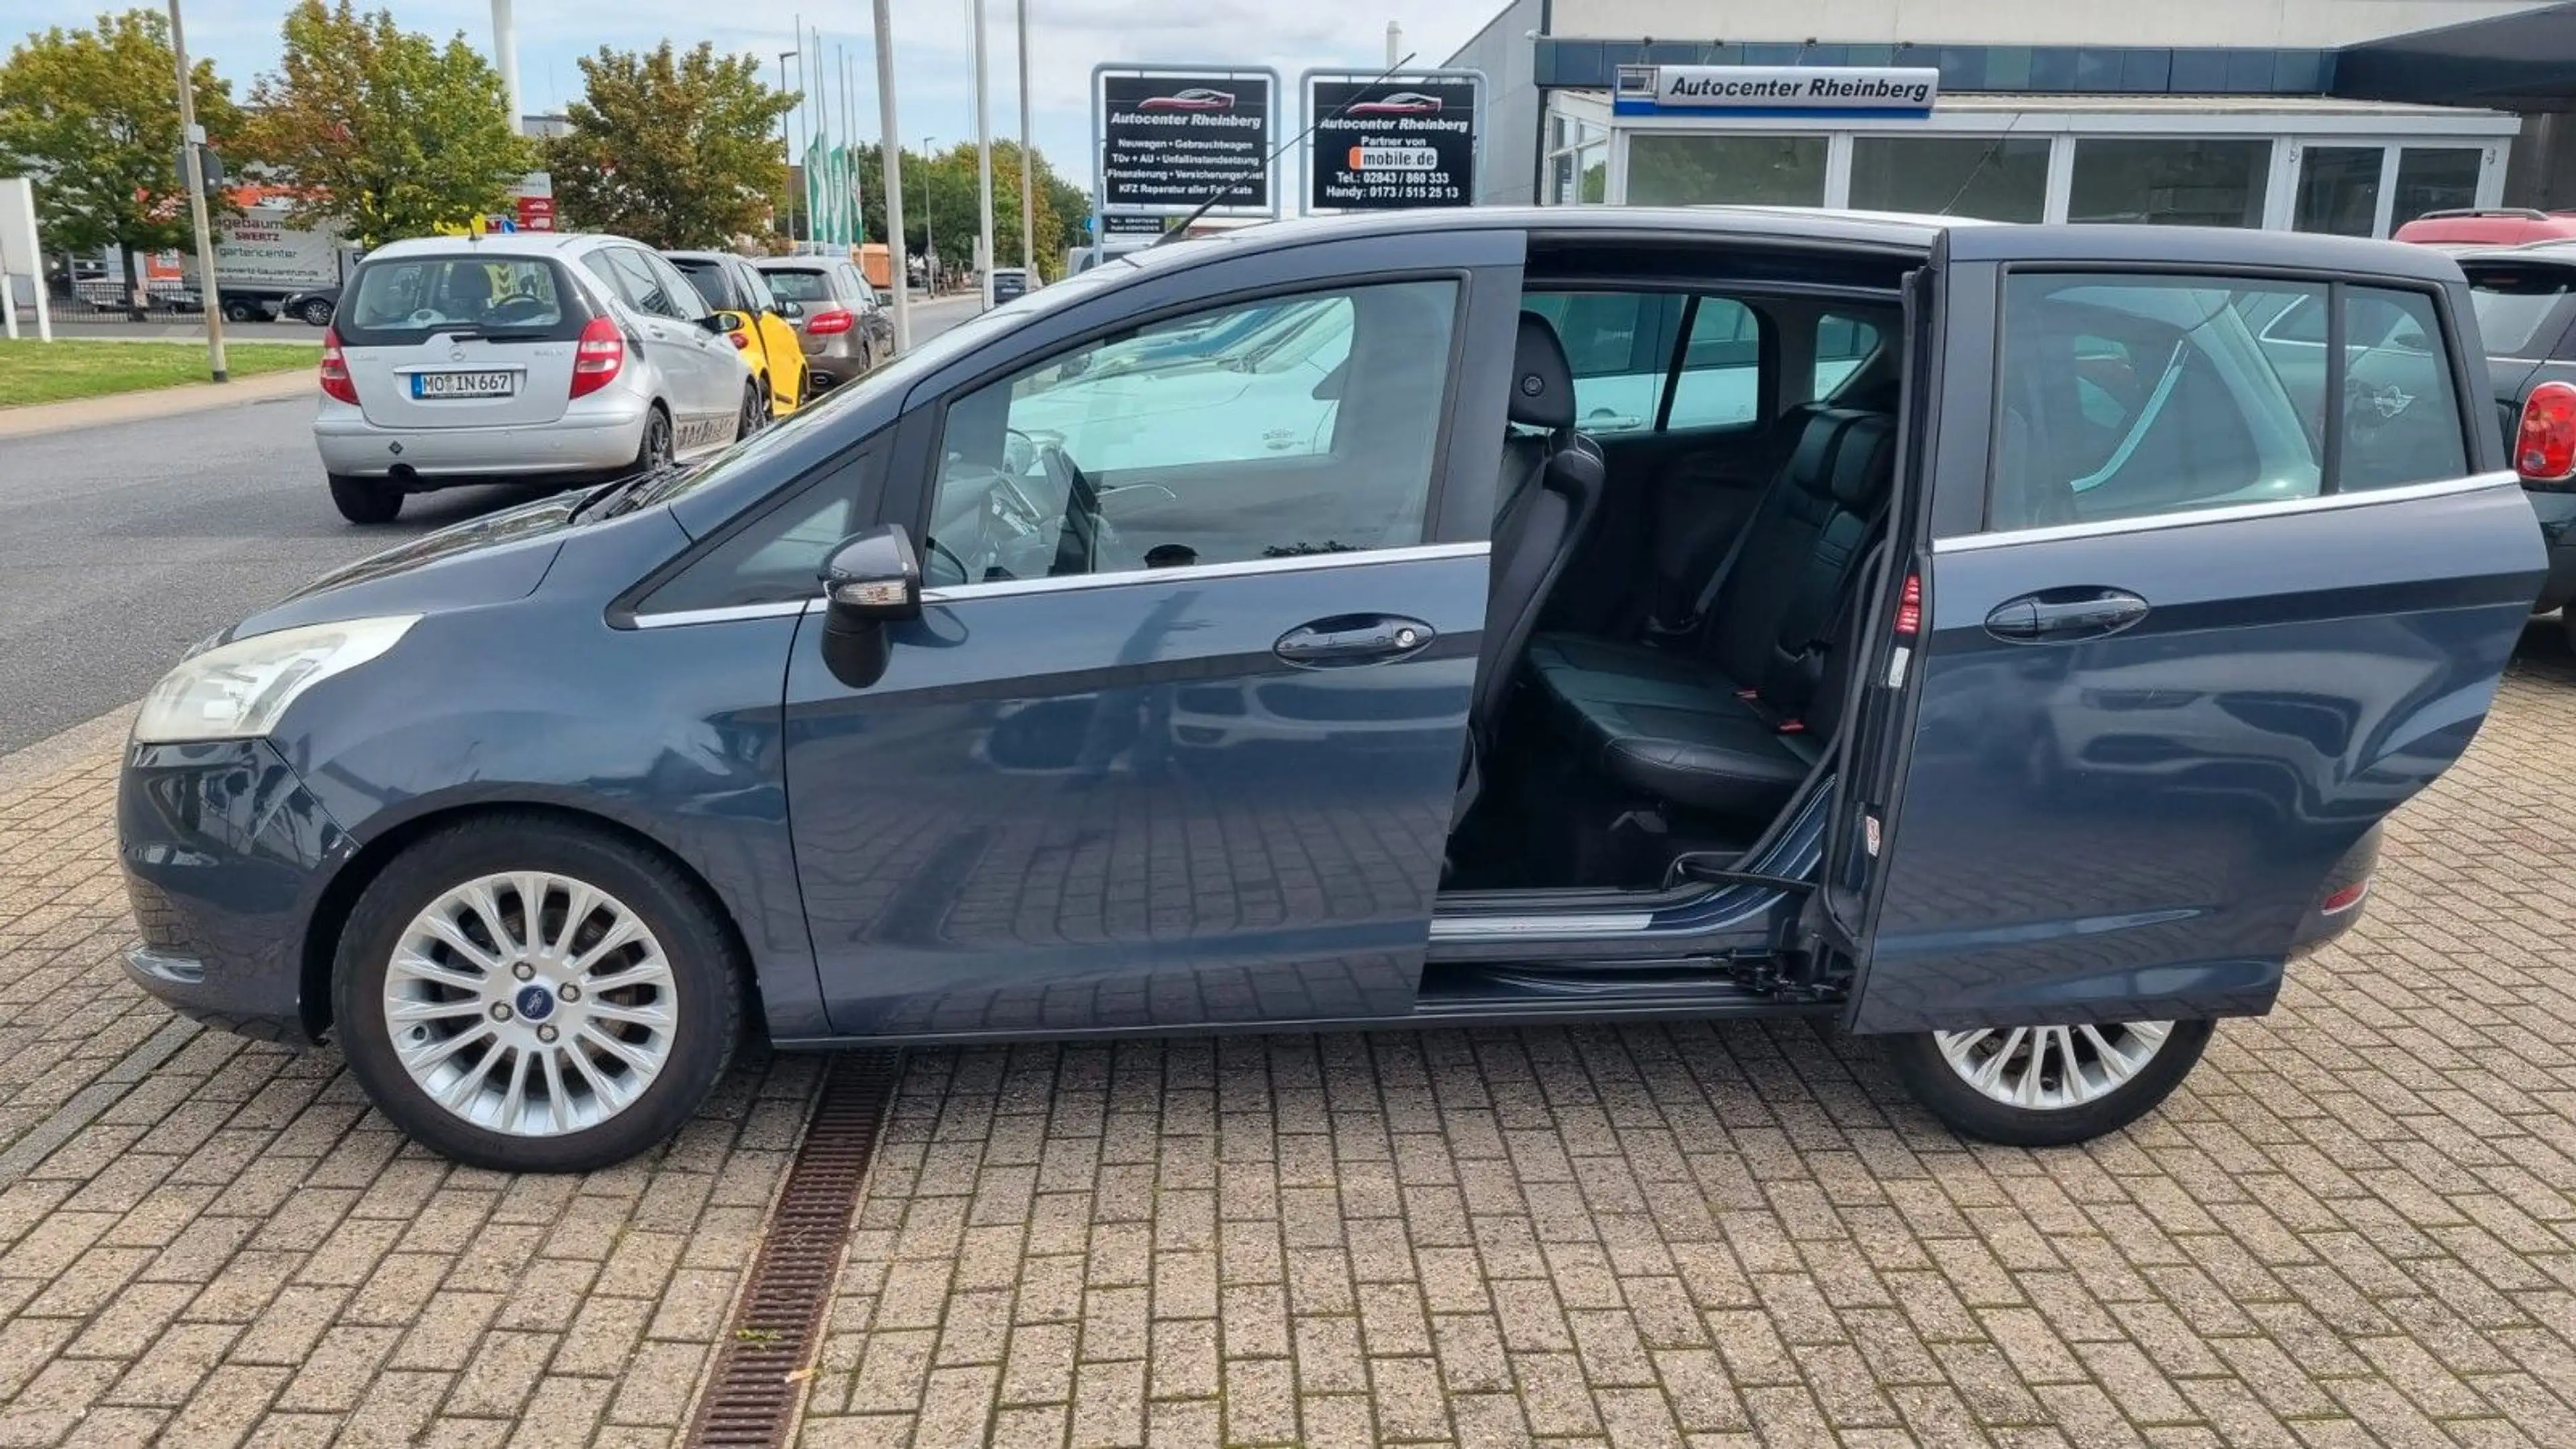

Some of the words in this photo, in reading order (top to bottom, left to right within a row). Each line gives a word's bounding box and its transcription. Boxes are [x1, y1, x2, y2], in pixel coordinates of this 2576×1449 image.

[1670, 77, 1802, 97] Autocenter
[1809, 78, 1929, 102] Rheinberg
[1111, 112, 1188, 125] Autocenter
[1191, 113, 1262, 129] Rheinberg
[1320, 117, 1395, 129] Autocenter
[1399, 117, 1468, 133] Rheinberg
[1118, 138, 1167, 150] Neuwagen
[1175, 139, 1253, 152] Gebrauchtwagen
[1360, 136, 1402, 146] Partner
[1405, 138, 1426, 146] von
[1140, 154, 1155, 164] AU
[1162, 154, 1260, 166] Unfallinstandsetzung
[1363, 152, 1435, 166] mobile.de
[1108, 168, 1168, 180] Finanzierung
[1429, 172, 1450, 183] 333
[1118, 184, 1138, 194] KFZ
[1140, 184, 1186, 196] Reparatur
[1187, 184, 1208, 195] aller
[1326, 185, 1366, 200] Handy:
[1369, 186, 1397, 198] 0173
[1446, 187, 1458, 198] 13
[219, 246, 297, 258] gartencenter
[424, 376, 445, 392] MO
[456, 376, 476, 391] IN
[479, 374, 508, 391] 667
